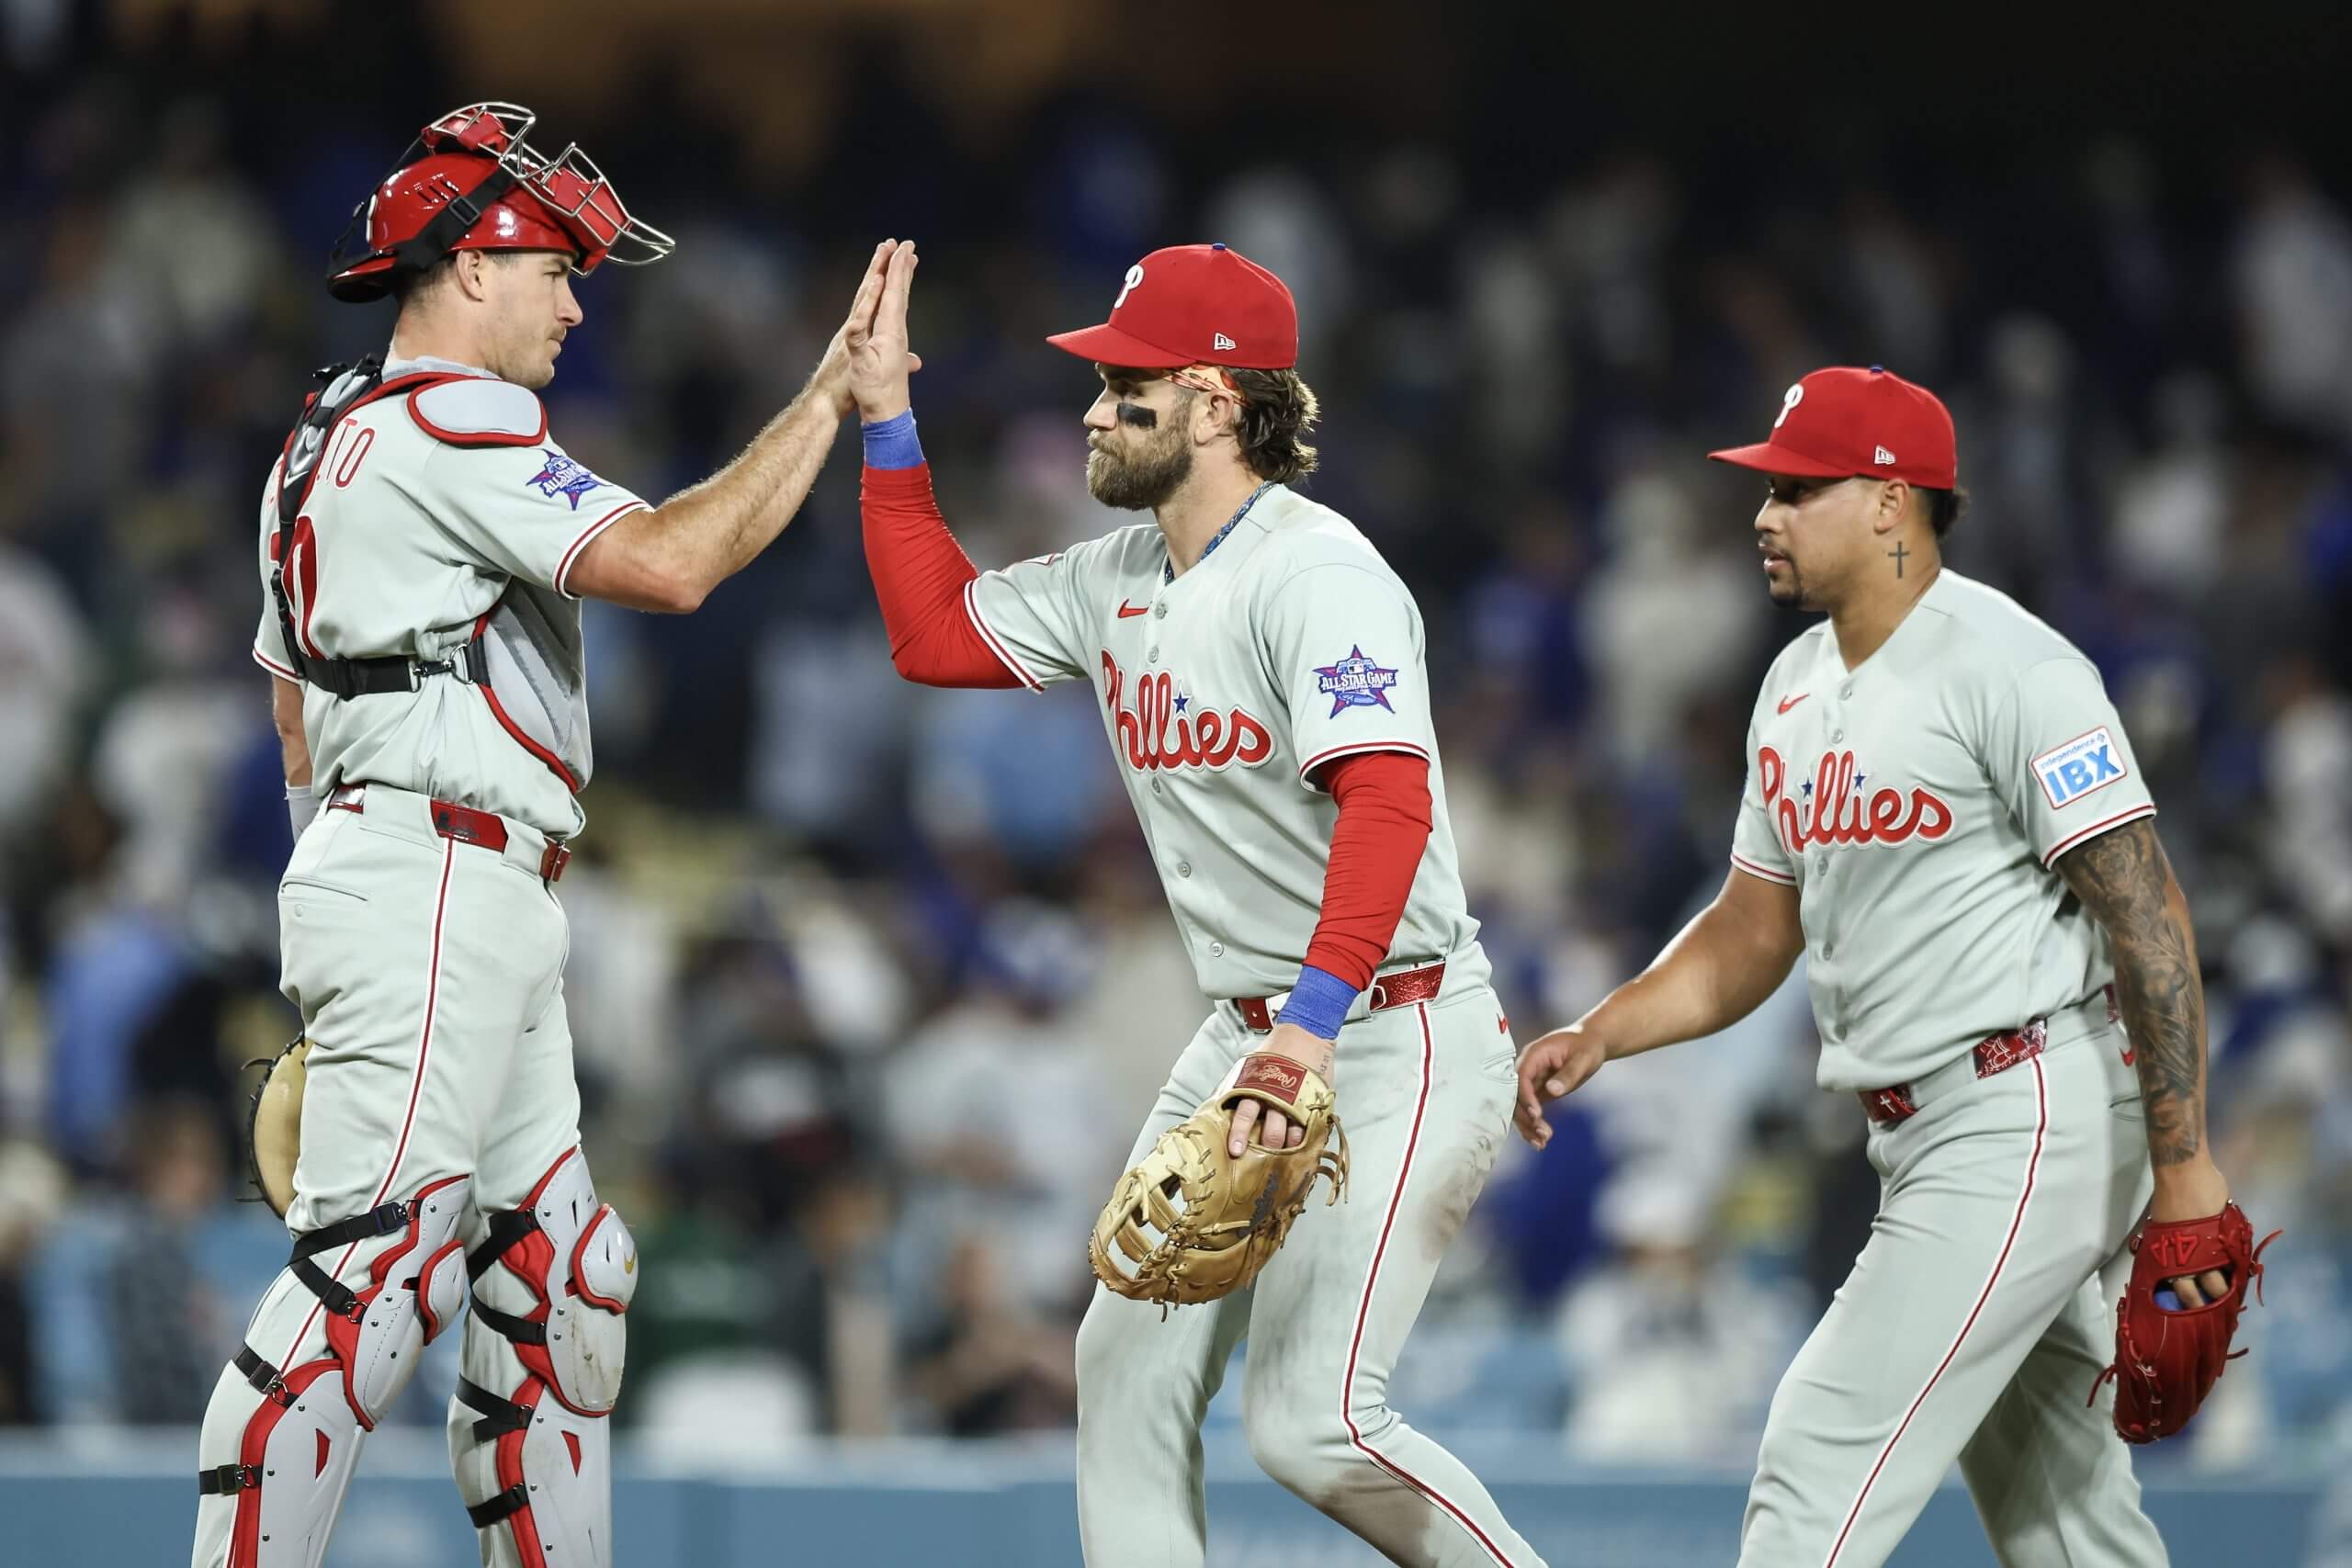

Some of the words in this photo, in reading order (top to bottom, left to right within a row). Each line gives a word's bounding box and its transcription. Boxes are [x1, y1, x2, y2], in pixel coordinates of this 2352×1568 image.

[1114, 264, 1145, 310] P
[1773, 383, 1804, 429] P
[2045, 744, 2120, 803] IBX
[1758, 745, 1952, 859] Phillies
